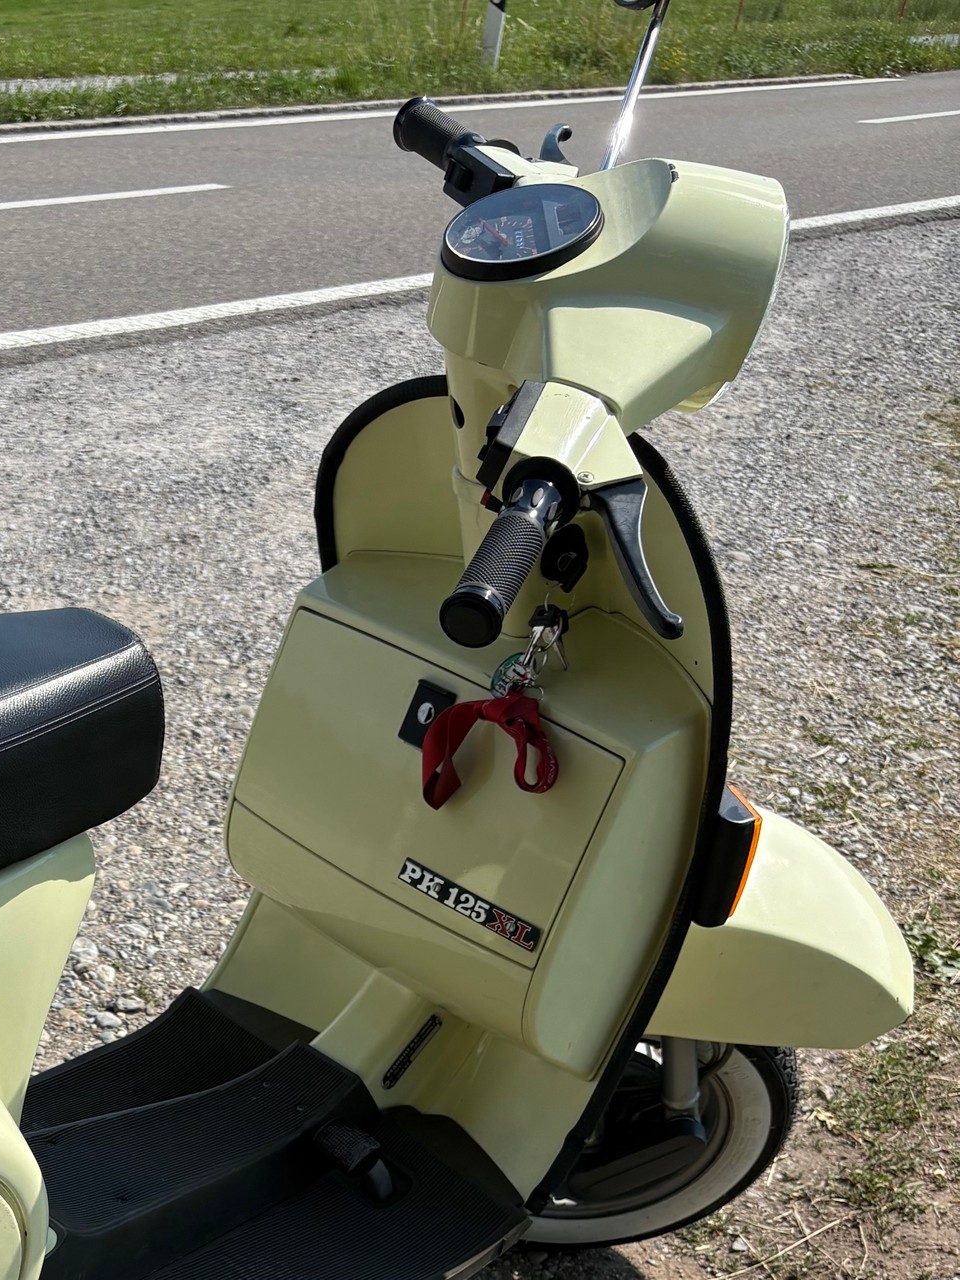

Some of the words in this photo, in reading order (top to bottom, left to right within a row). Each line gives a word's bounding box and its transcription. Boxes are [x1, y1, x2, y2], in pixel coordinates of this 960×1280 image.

[399, 861, 444, 899] PK
[444, 887, 490, 923] 125
[486, 908, 534, 951] XL
